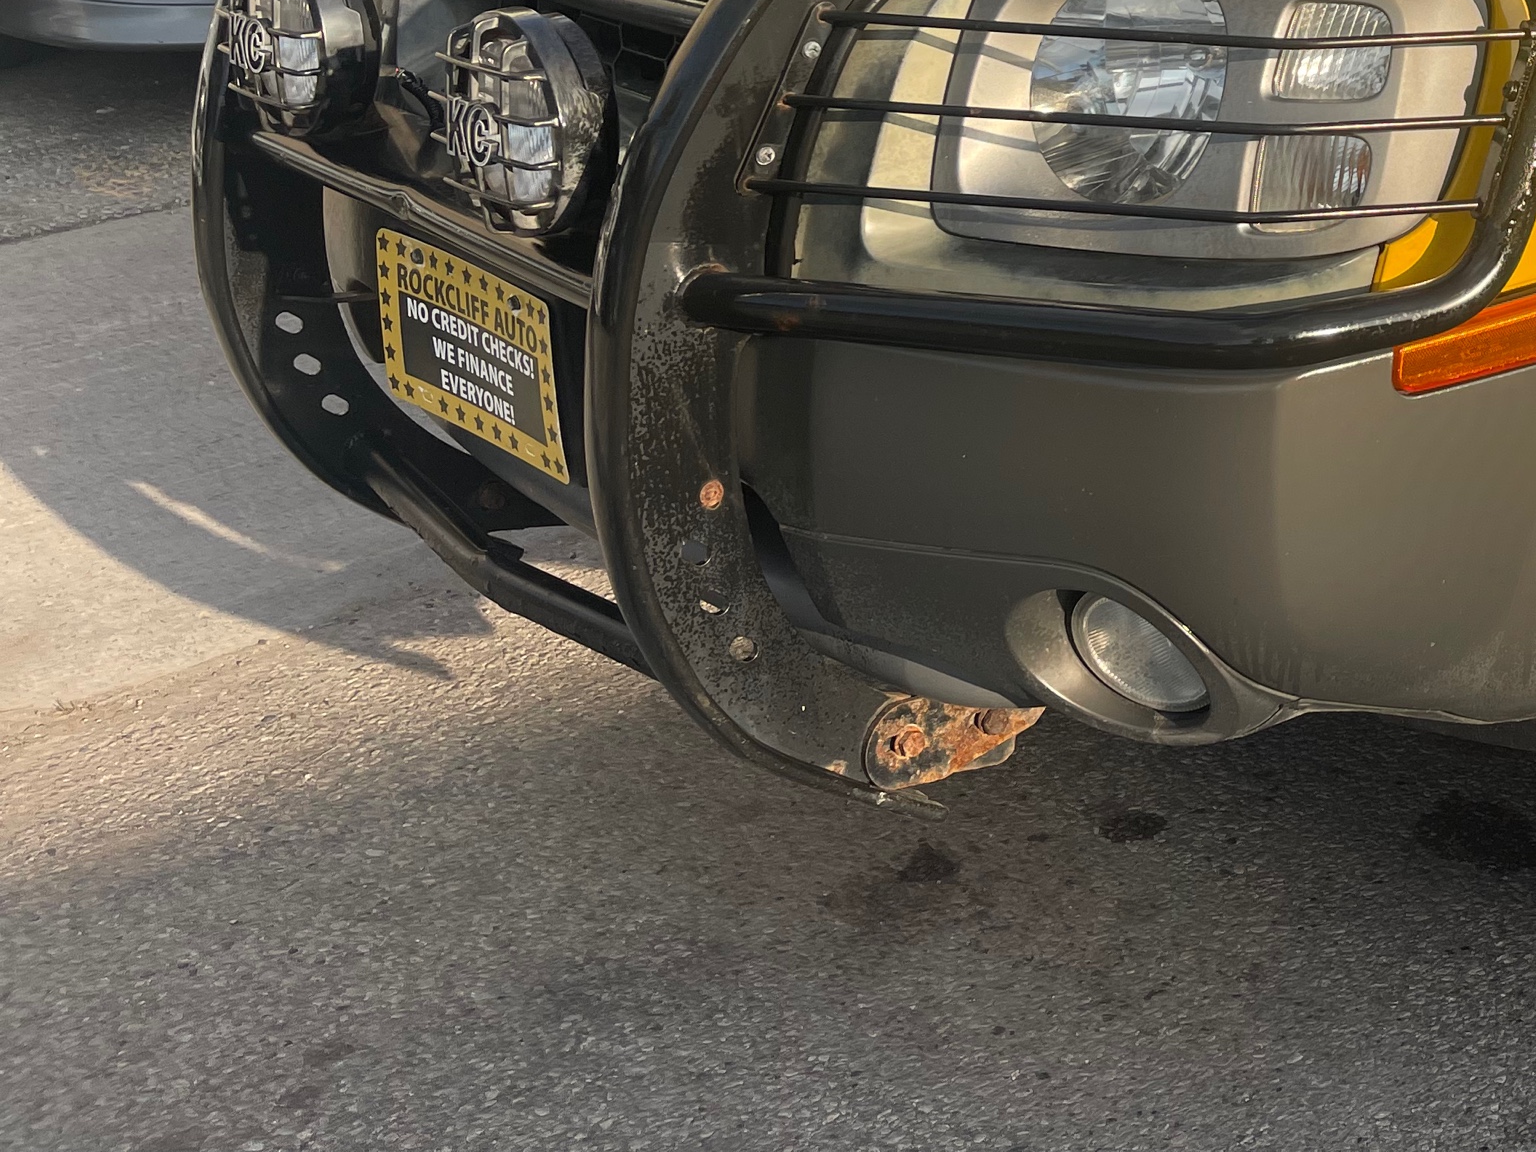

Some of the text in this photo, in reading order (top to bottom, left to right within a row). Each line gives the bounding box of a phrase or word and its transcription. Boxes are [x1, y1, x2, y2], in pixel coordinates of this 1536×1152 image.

[447, 96, 500, 168] KC
[396, 262, 538, 354] ROCKCLIFF AUTO
[406, 296, 536, 380] NO CREDIT CHECKS!
[432, 335, 515, 397] WE FINANCE
[440, 368, 517, 426] EVERYONE!
